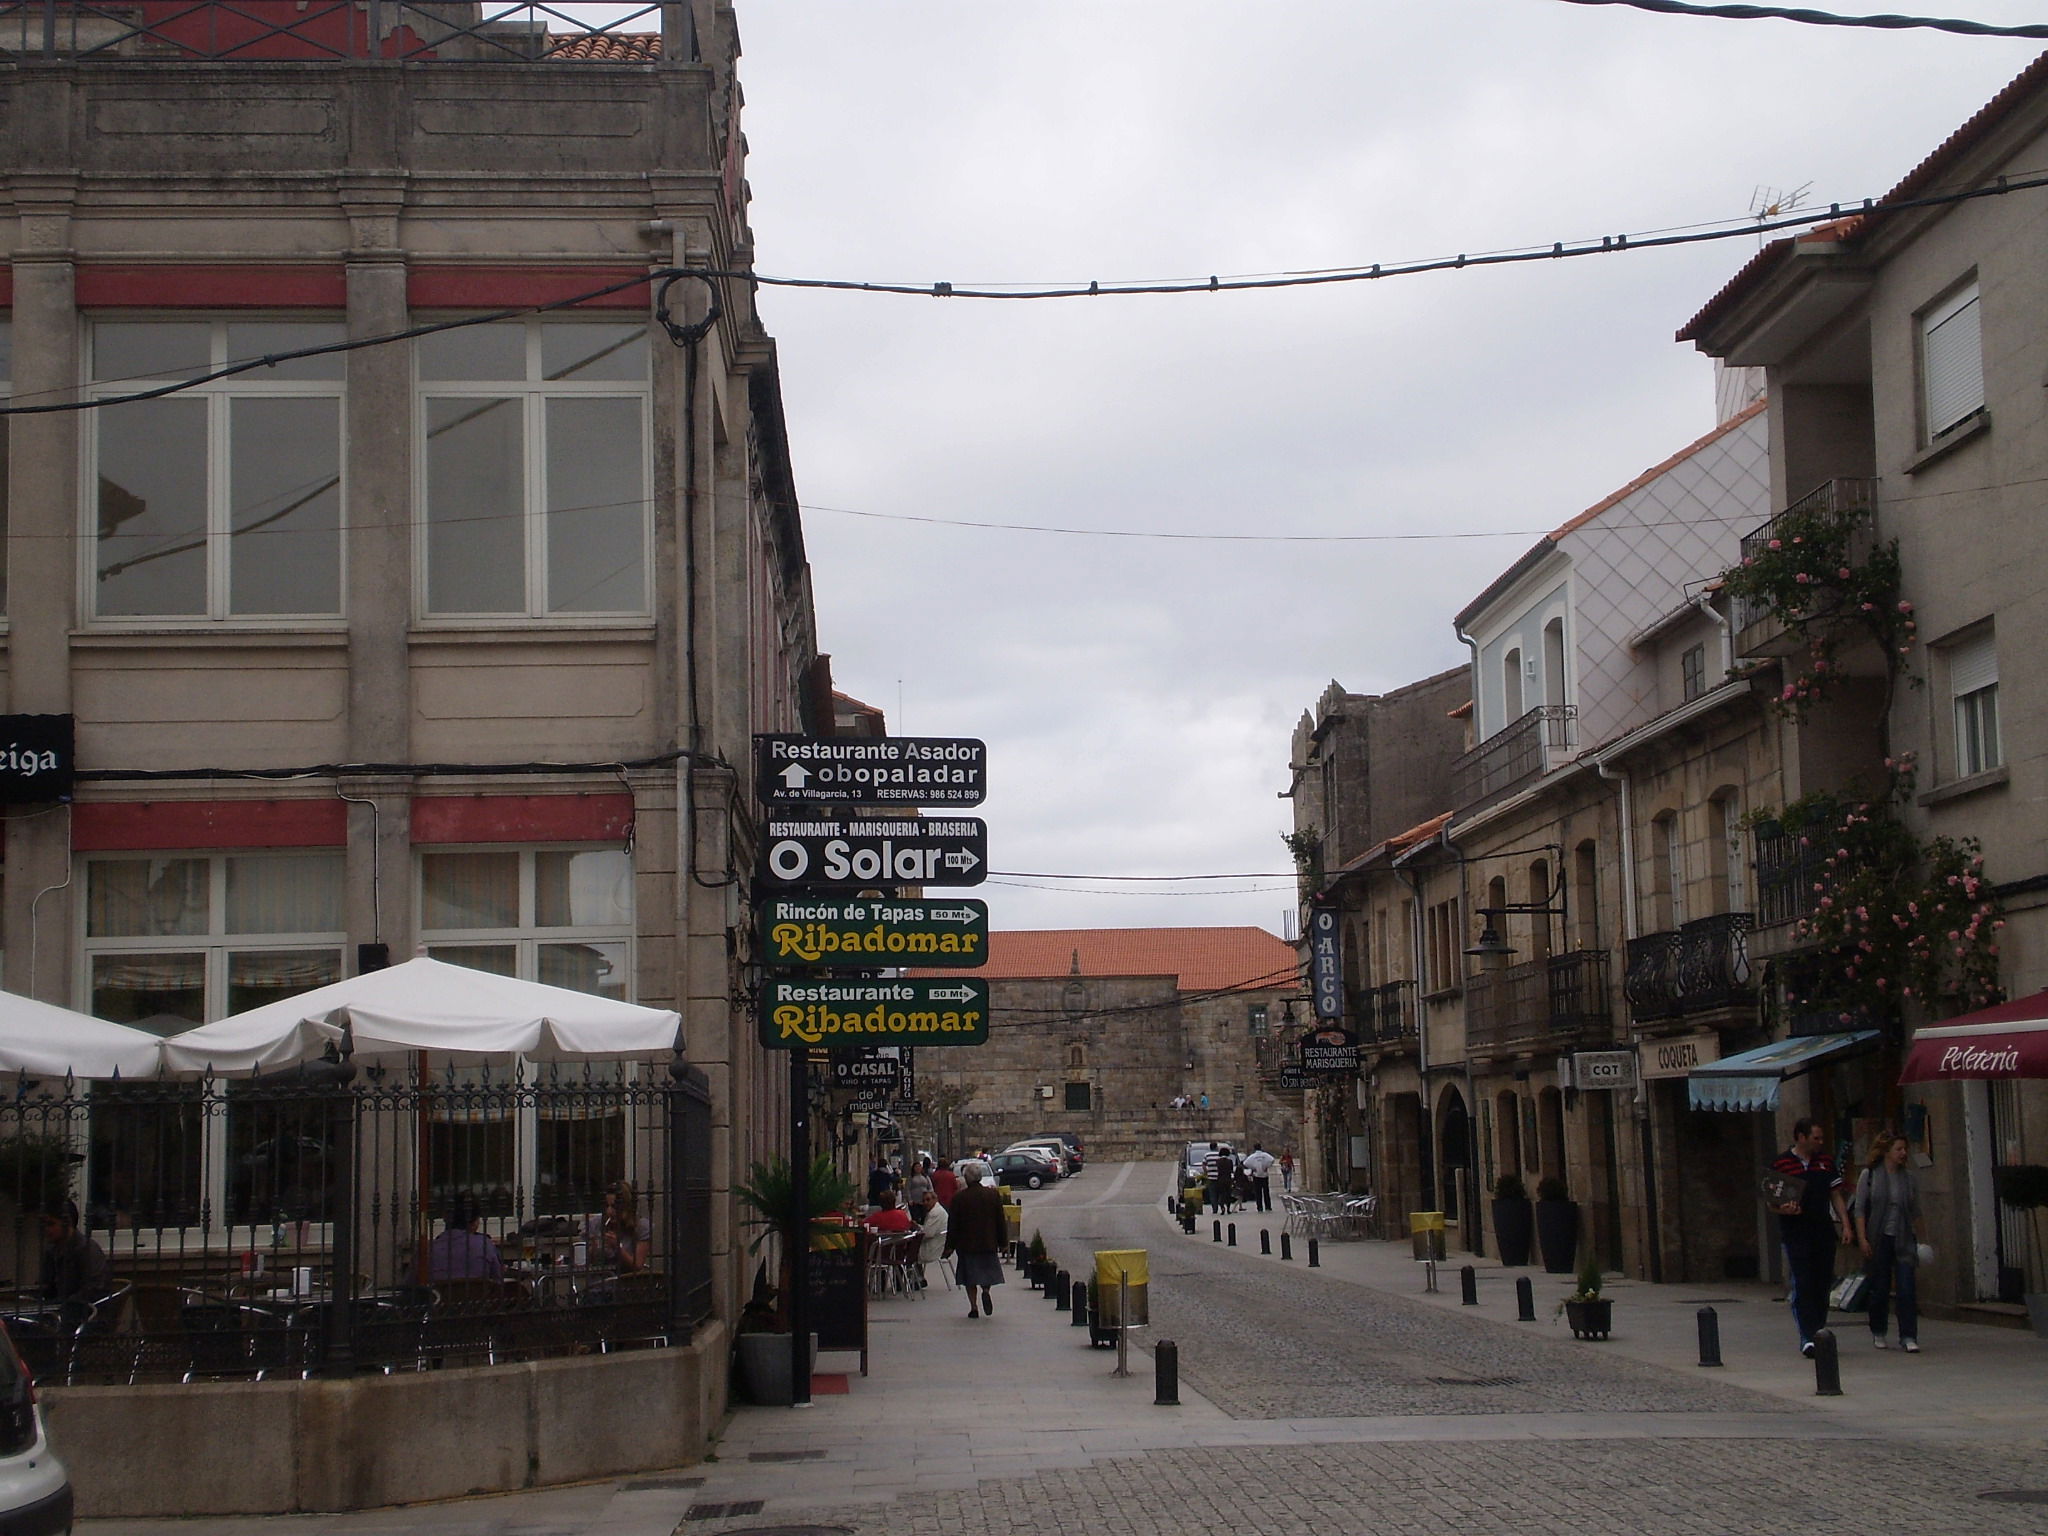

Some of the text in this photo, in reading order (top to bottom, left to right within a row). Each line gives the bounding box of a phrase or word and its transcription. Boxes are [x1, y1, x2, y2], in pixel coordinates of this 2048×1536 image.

[772, 741, 980, 760] Restaurante Asador
[818, 764, 978, 786] obopaladar
[773, 789, 787, 798] Av.
[789, 789, 800, 798] de
[851, 790, 862, 798] 13
[877, 790, 979, 800] RESERVAS: 986 524 899
[770, 822, 978, 837] RESTAURANTE MARISQUERIA BRASERIA
[769, 839, 941, 880] O Solar
[947, 855, 973, 865] 100 Mts
[776, 903, 924, 924] Rincón de Tapas
[935, 910, 971, 919] 50 Mts
[1318, 913, 1333, 930] O
[772, 923, 979, 961] Ribadomar
[777, 984, 914, 1001] Restaurante
[933, 989, 969, 998] 50 Mts
[773, 1004, 980, 1043] Ribadomar
[1304, 1047, 1357, 1058] RESTAURANTE
[1658, 1043, 1698, 1069] COQUETA
[838, 1062, 895, 1076] O CASAL
[1305, 1058, 1358, 1069] MARISQUERIA
[1592, 1065, 1619, 1075] CQT
[858, 1090, 874, 1100] de
[849, 1100, 883, 1111] miguel
